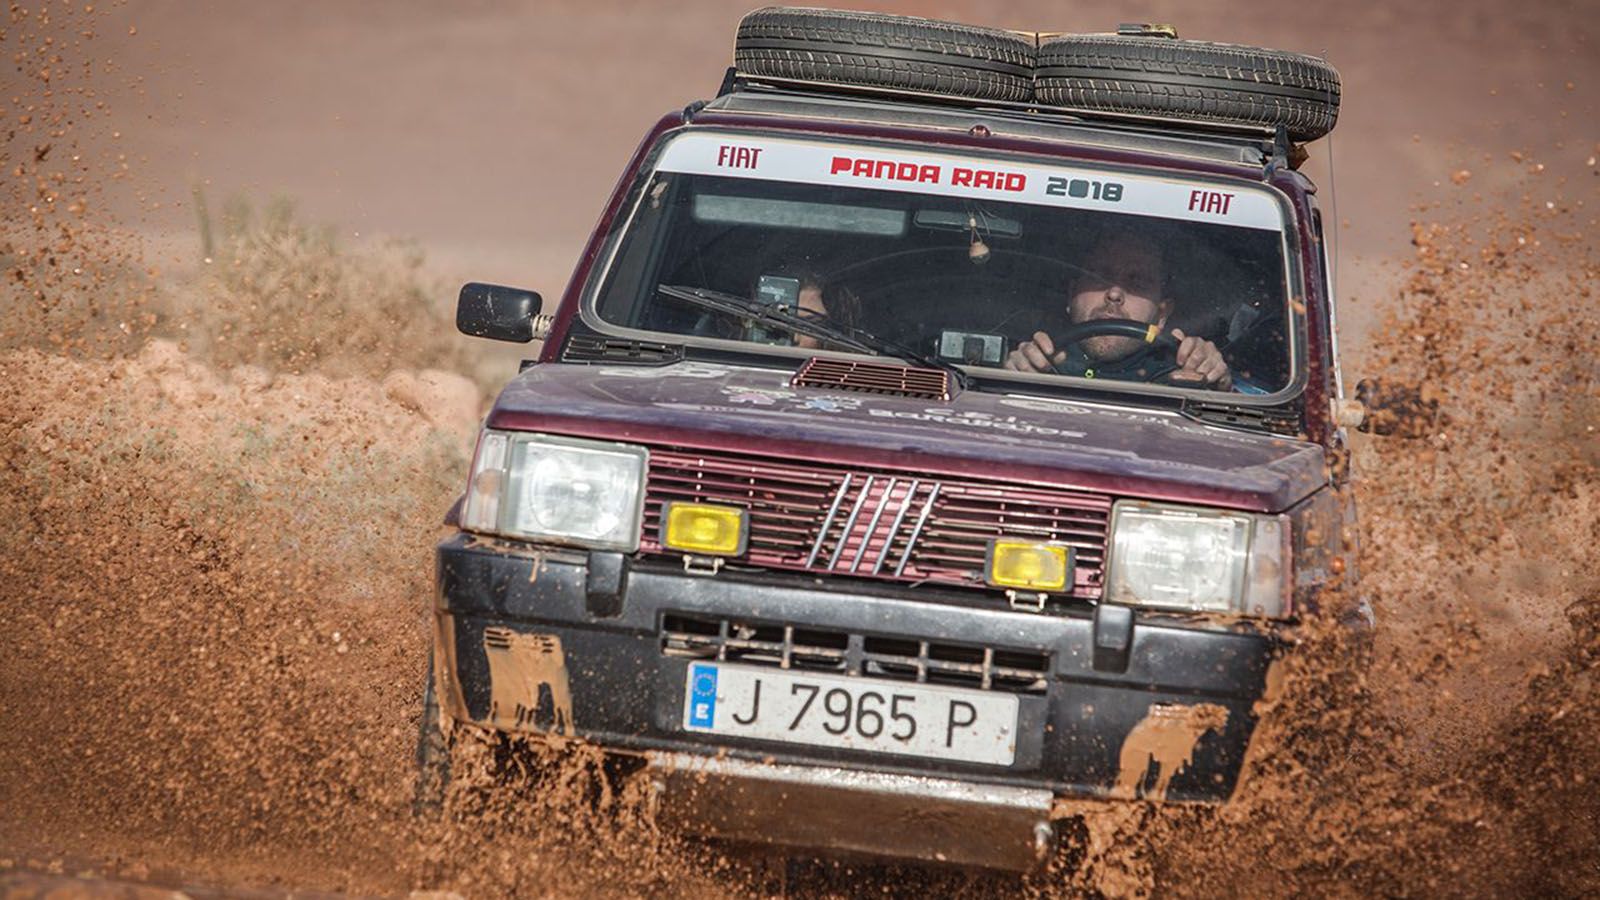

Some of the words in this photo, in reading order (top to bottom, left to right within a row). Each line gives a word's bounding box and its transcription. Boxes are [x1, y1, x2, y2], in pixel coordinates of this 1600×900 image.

[718, 145, 762, 169] FIAT
[831, 156, 941, 184] PANDA
[1046, 176, 1124, 202] 2018
[1189, 189, 1234, 215] FIAT
[695, 703, 709, 719] E
[732, 679, 762, 725] J
[789, 683, 917, 741] 7965
[946, 699, 978, 748] P
